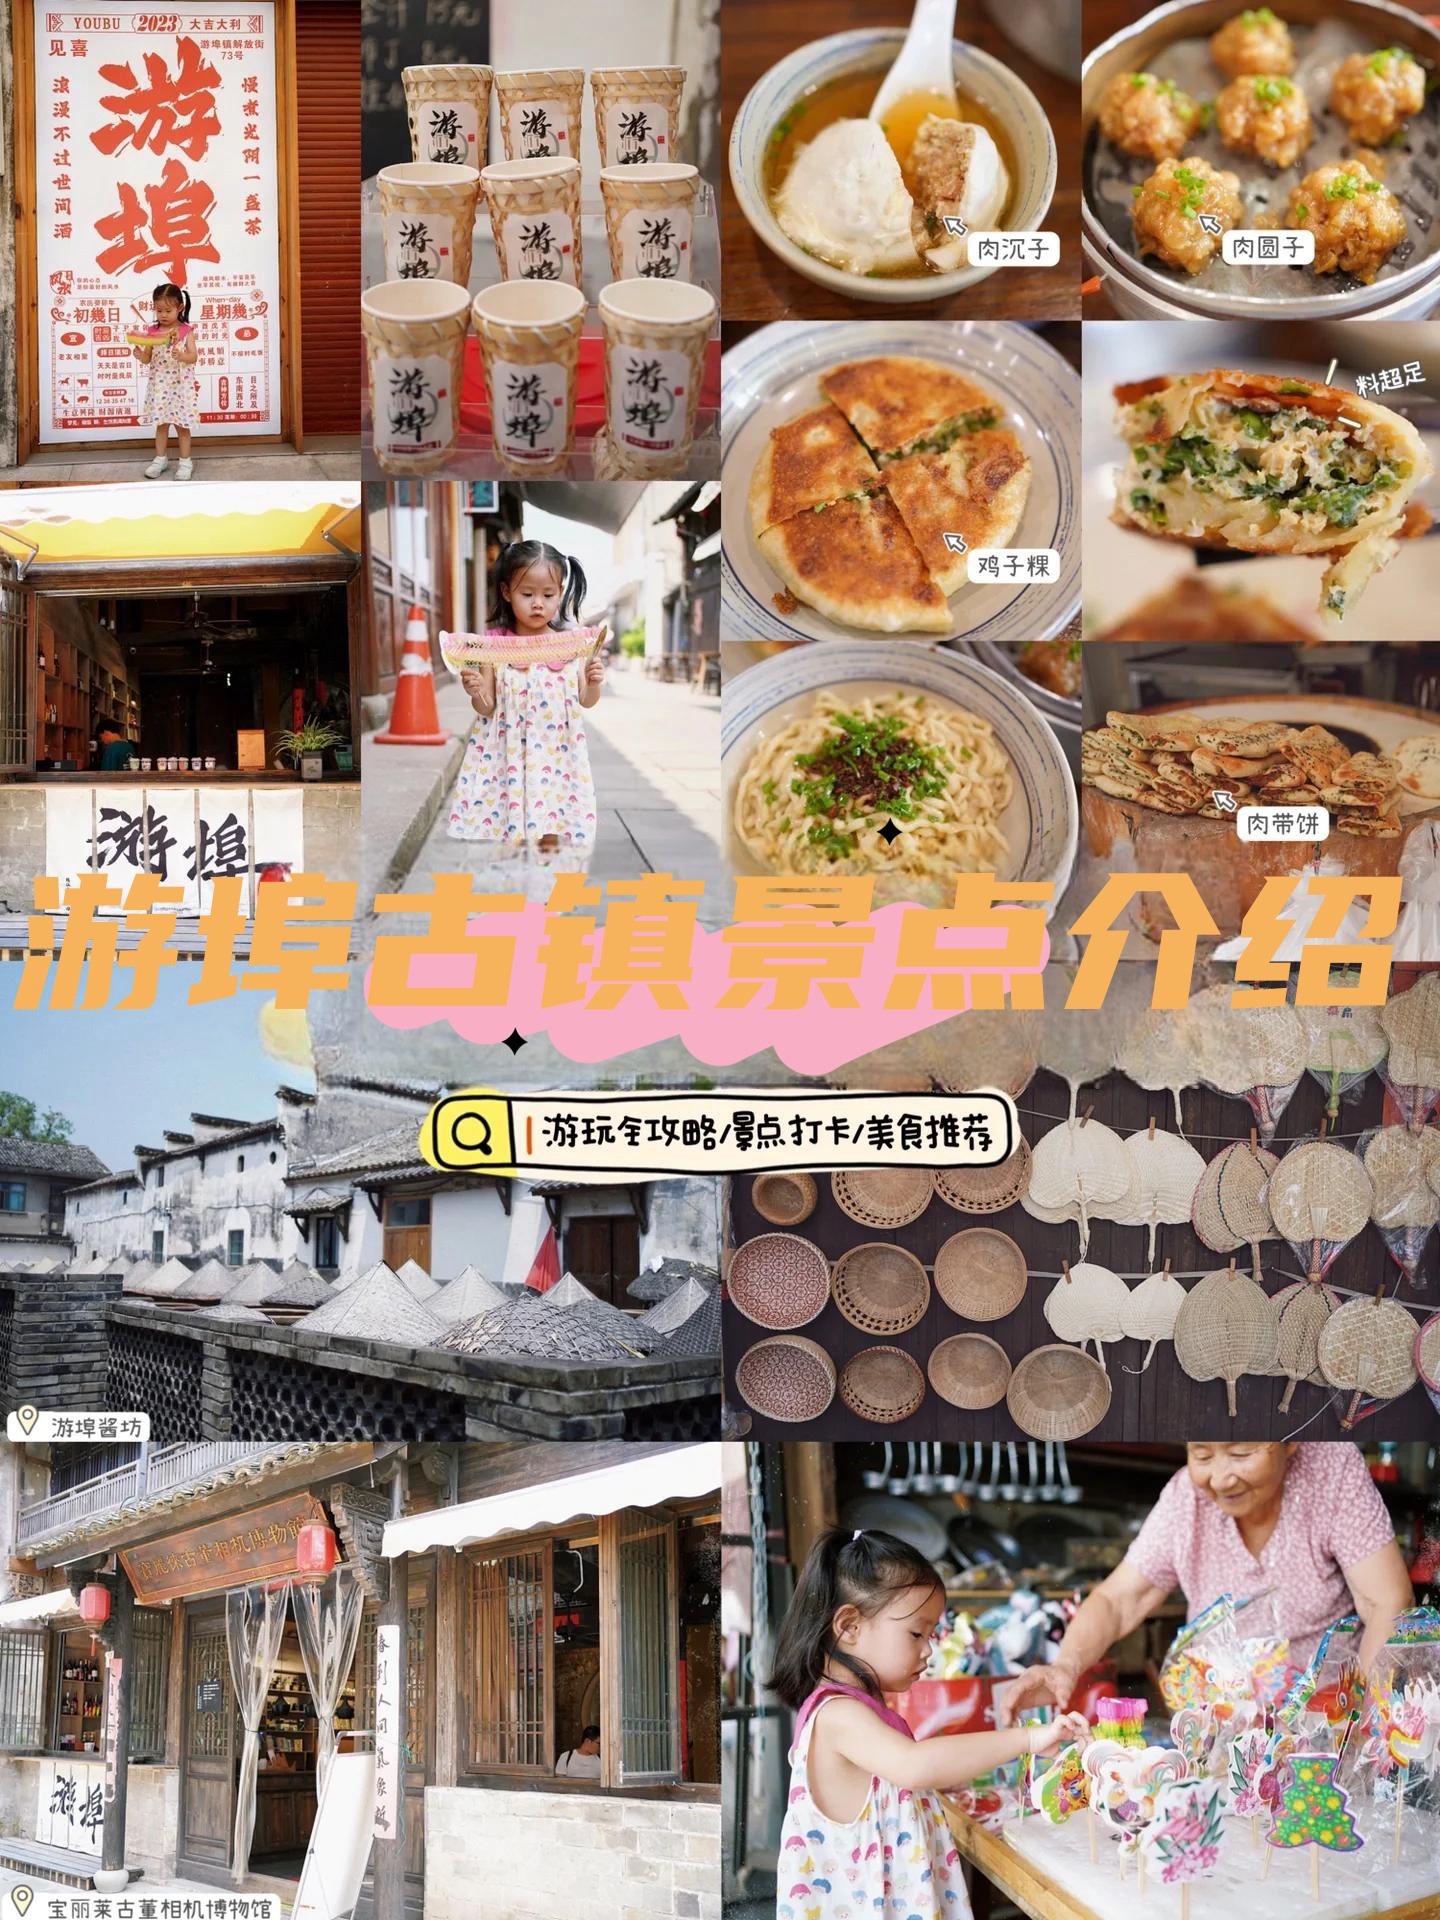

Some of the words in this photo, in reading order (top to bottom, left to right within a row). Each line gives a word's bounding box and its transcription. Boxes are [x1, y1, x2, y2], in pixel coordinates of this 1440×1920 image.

[73, 18, 121, 30] YOUBU
[136, 14, 179, 32] 2023
[189, 18, 242, 31] 大吉大利
[49, 39, 89, 57] 见喜
[200, 39, 265, 50] 游埠镇解放街
[221, 51, 244, 61] 73号
[89, 35, 224, 288] 游埠
[241, 75, 263, 235] 慢煮光阴一盏茶
[73, 307, 120, 323] 初幾日
[200, 303, 247, 320] 星期幾
[388, 367, 430, 443] 游埠
[624, 356, 669, 439] 游埠
[505, 373, 547, 448] 游埠
